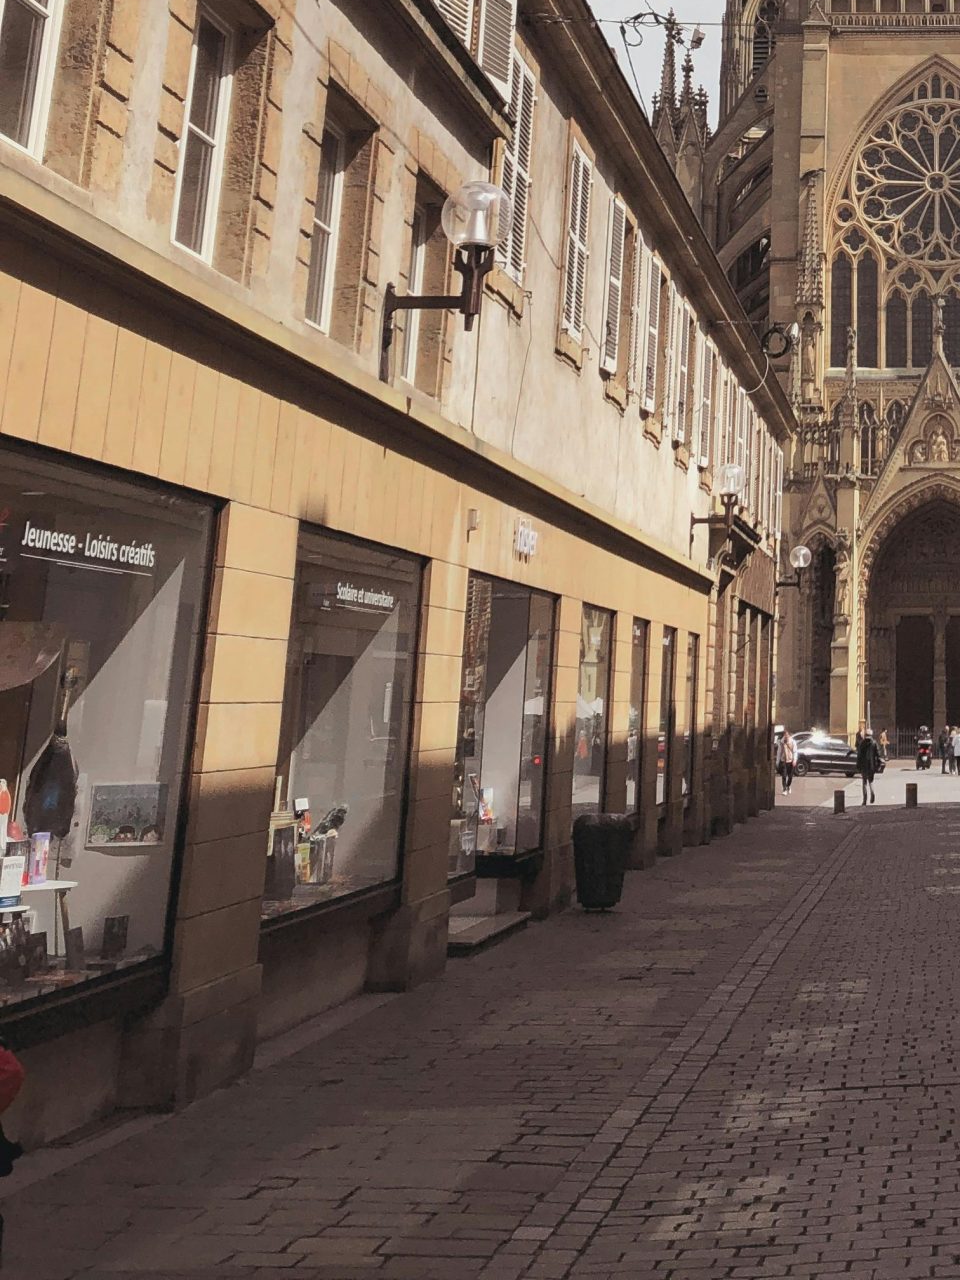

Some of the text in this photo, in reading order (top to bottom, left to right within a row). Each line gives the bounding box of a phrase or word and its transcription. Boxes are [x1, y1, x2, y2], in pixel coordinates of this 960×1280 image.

[21, 520, 76, 554] Jeunesse
[84, 533, 118, 561] Loisirs
[118, 540, 156, 568] créatifs
[336, 582, 358, 602] Scolaire
[358, 588, 364, 603] et
